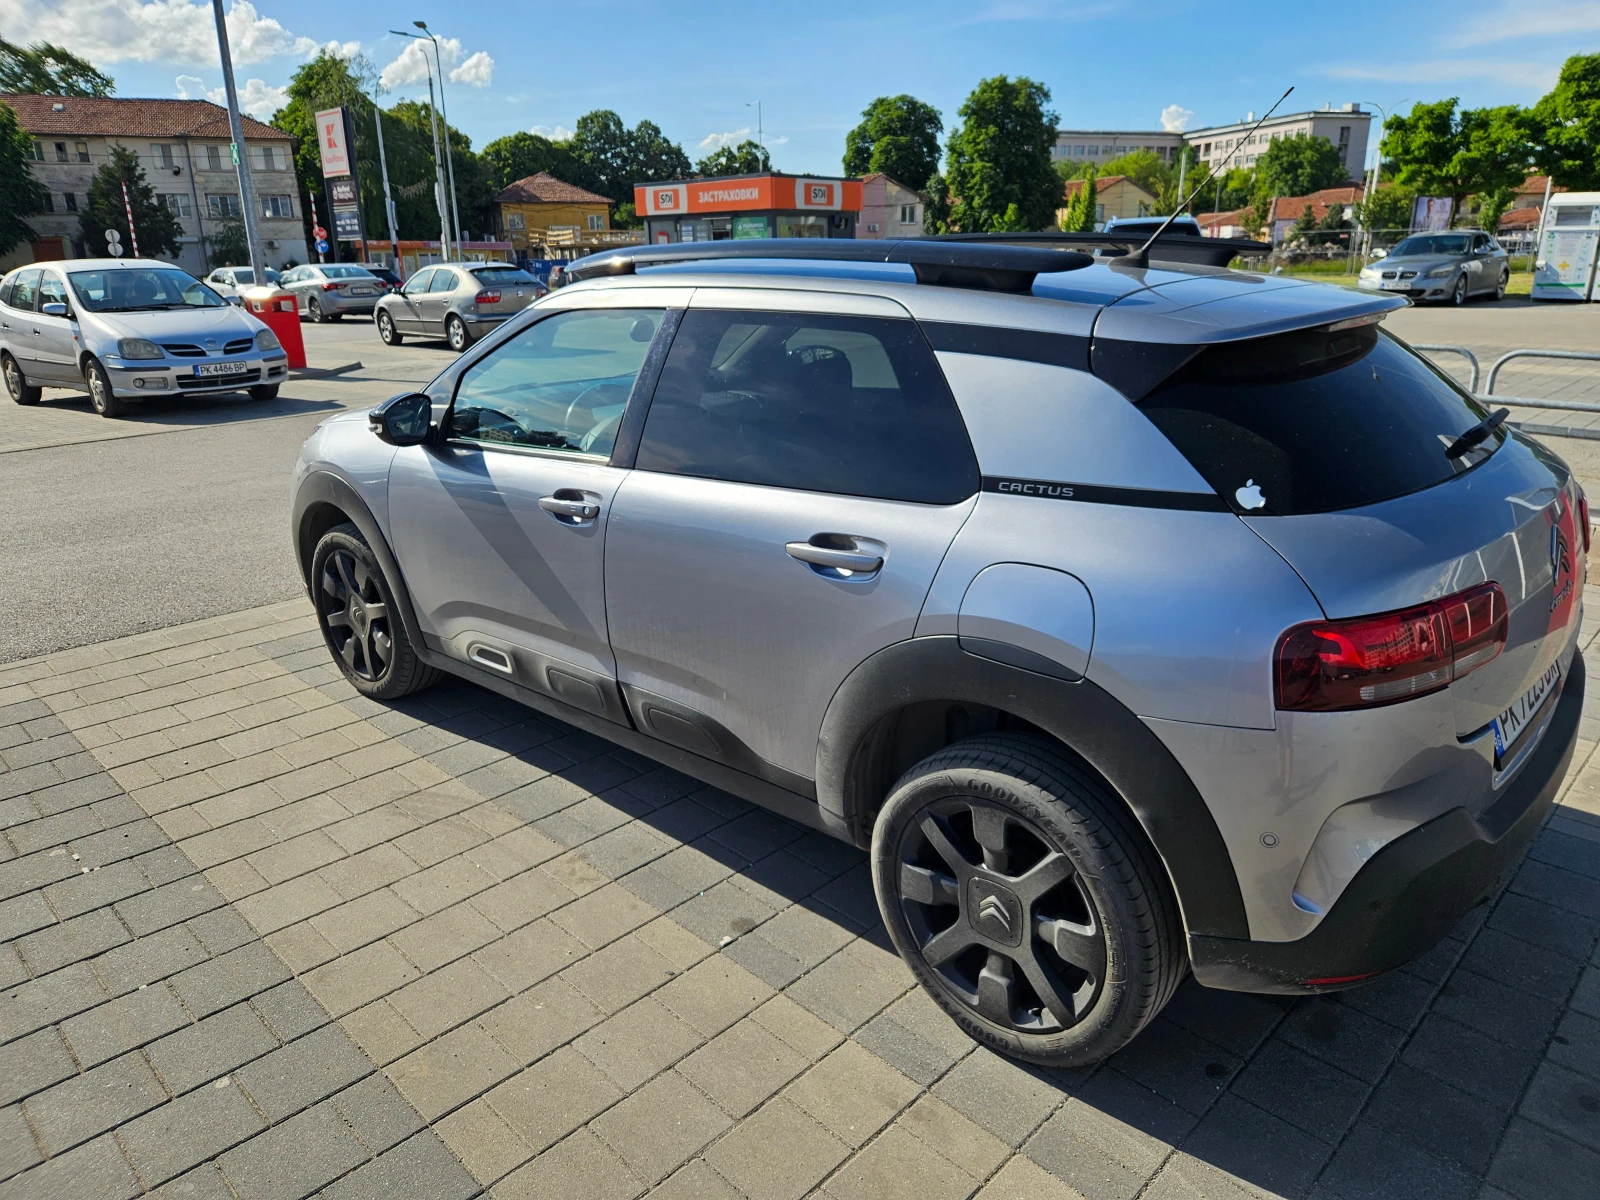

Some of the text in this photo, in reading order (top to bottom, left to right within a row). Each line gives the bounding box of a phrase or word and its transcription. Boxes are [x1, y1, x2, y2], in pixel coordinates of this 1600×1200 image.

[660, 194, 673, 204] SDI
[698, 188, 759, 203] ЗАСТРАХОВКИ
[812, 188, 826, 199] SDI
[200, 365, 212, 375] PK
[213, 364, 233, 373] 4486
[998, 482, 1074, 497] CACTUS
